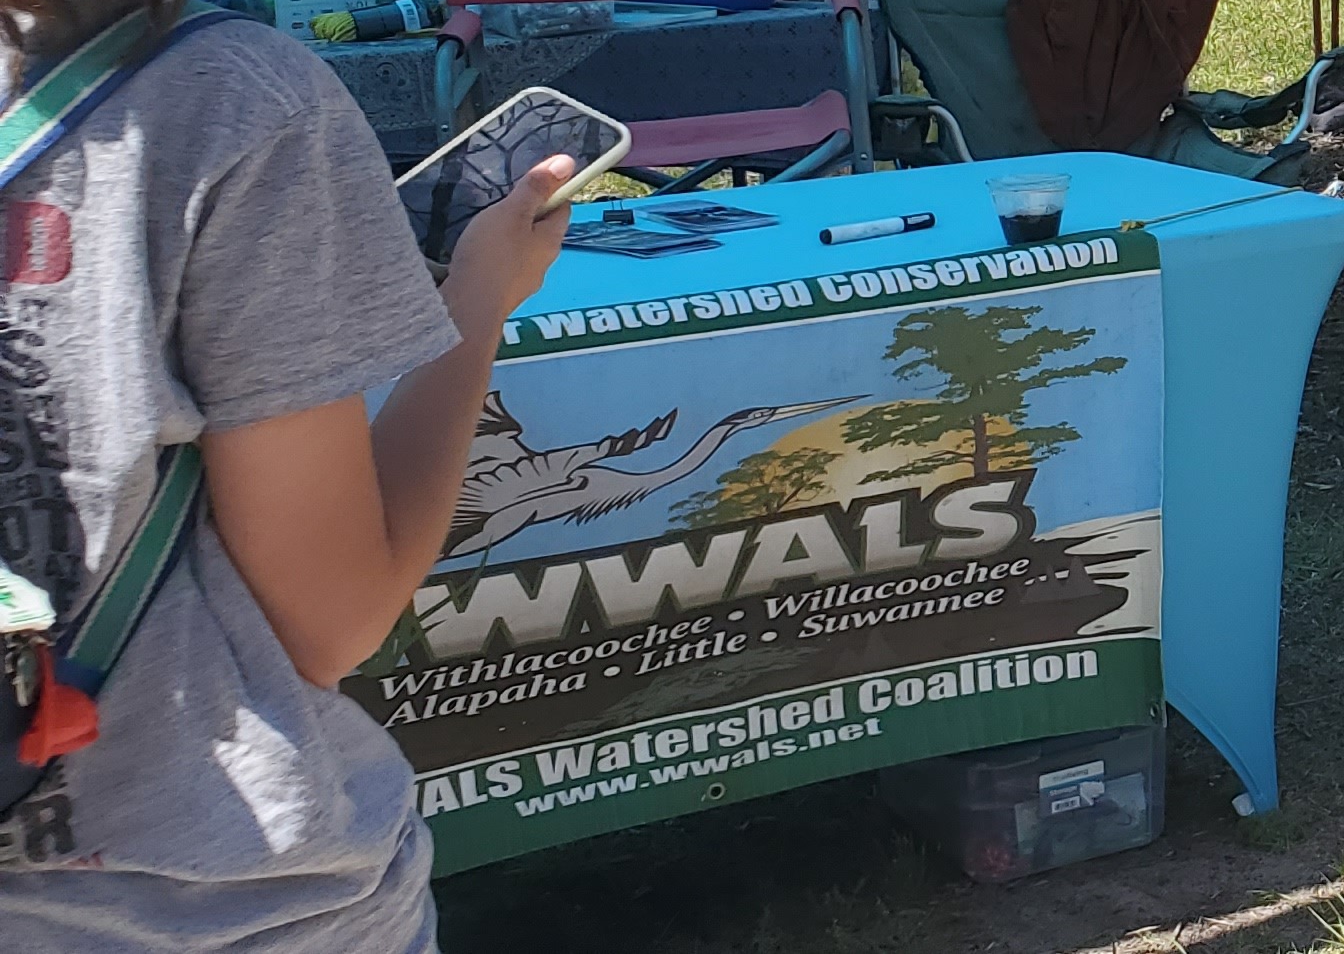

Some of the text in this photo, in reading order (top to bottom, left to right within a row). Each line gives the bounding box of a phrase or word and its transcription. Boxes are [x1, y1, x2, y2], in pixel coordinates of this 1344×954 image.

[531, 236, 1120, 341] Watershed Conservation
[379, 557, 1031, 701] Withlacoochee Willacoochee
[412, 480, 1019, 659] WWALS
[383, 586, 1005, 728] Alapaha Little Suwannee
[415, 648, 1099, 819] ALS Watershed Coalition
[514, 715, 884, 818] www.wwals.net
